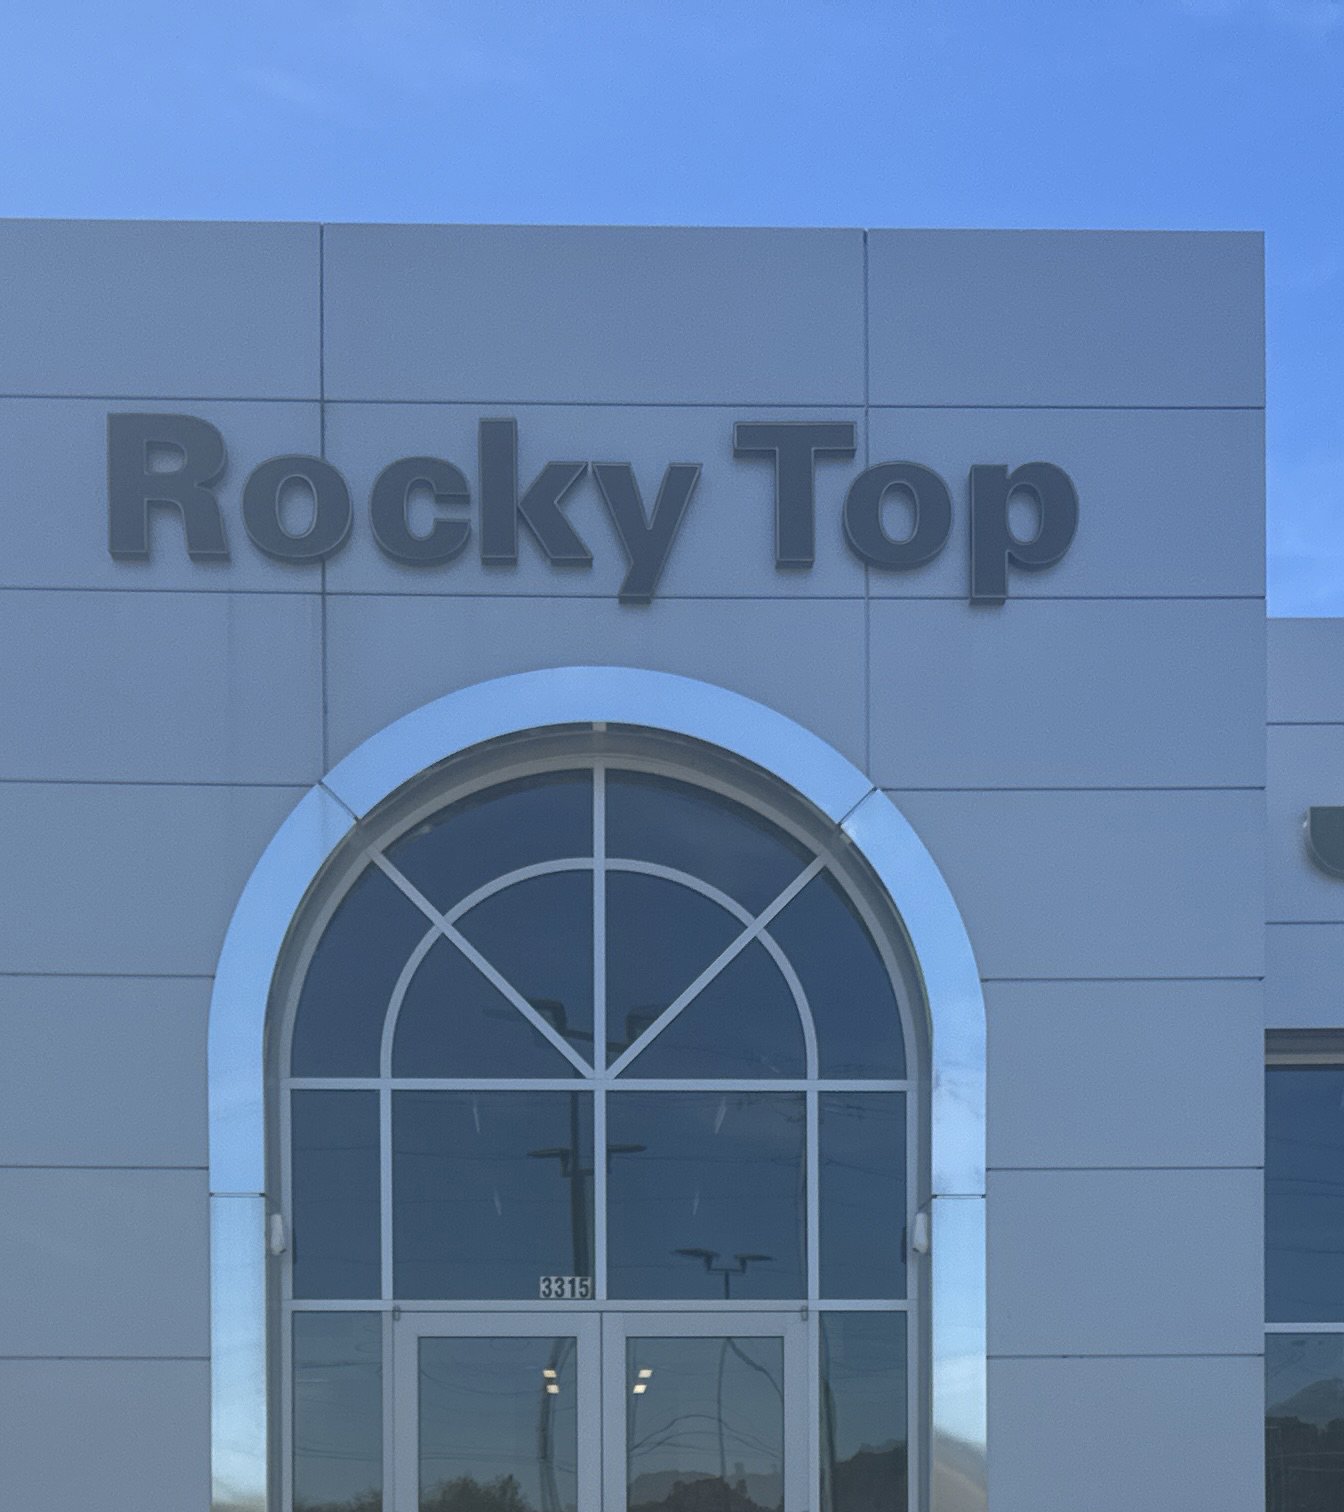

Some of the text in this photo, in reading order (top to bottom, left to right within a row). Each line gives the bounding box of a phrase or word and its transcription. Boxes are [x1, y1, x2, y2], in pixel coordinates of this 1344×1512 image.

[106, 412, 1080, 607] Rocky Top
[541, 1276, 590, 1298] 3315
